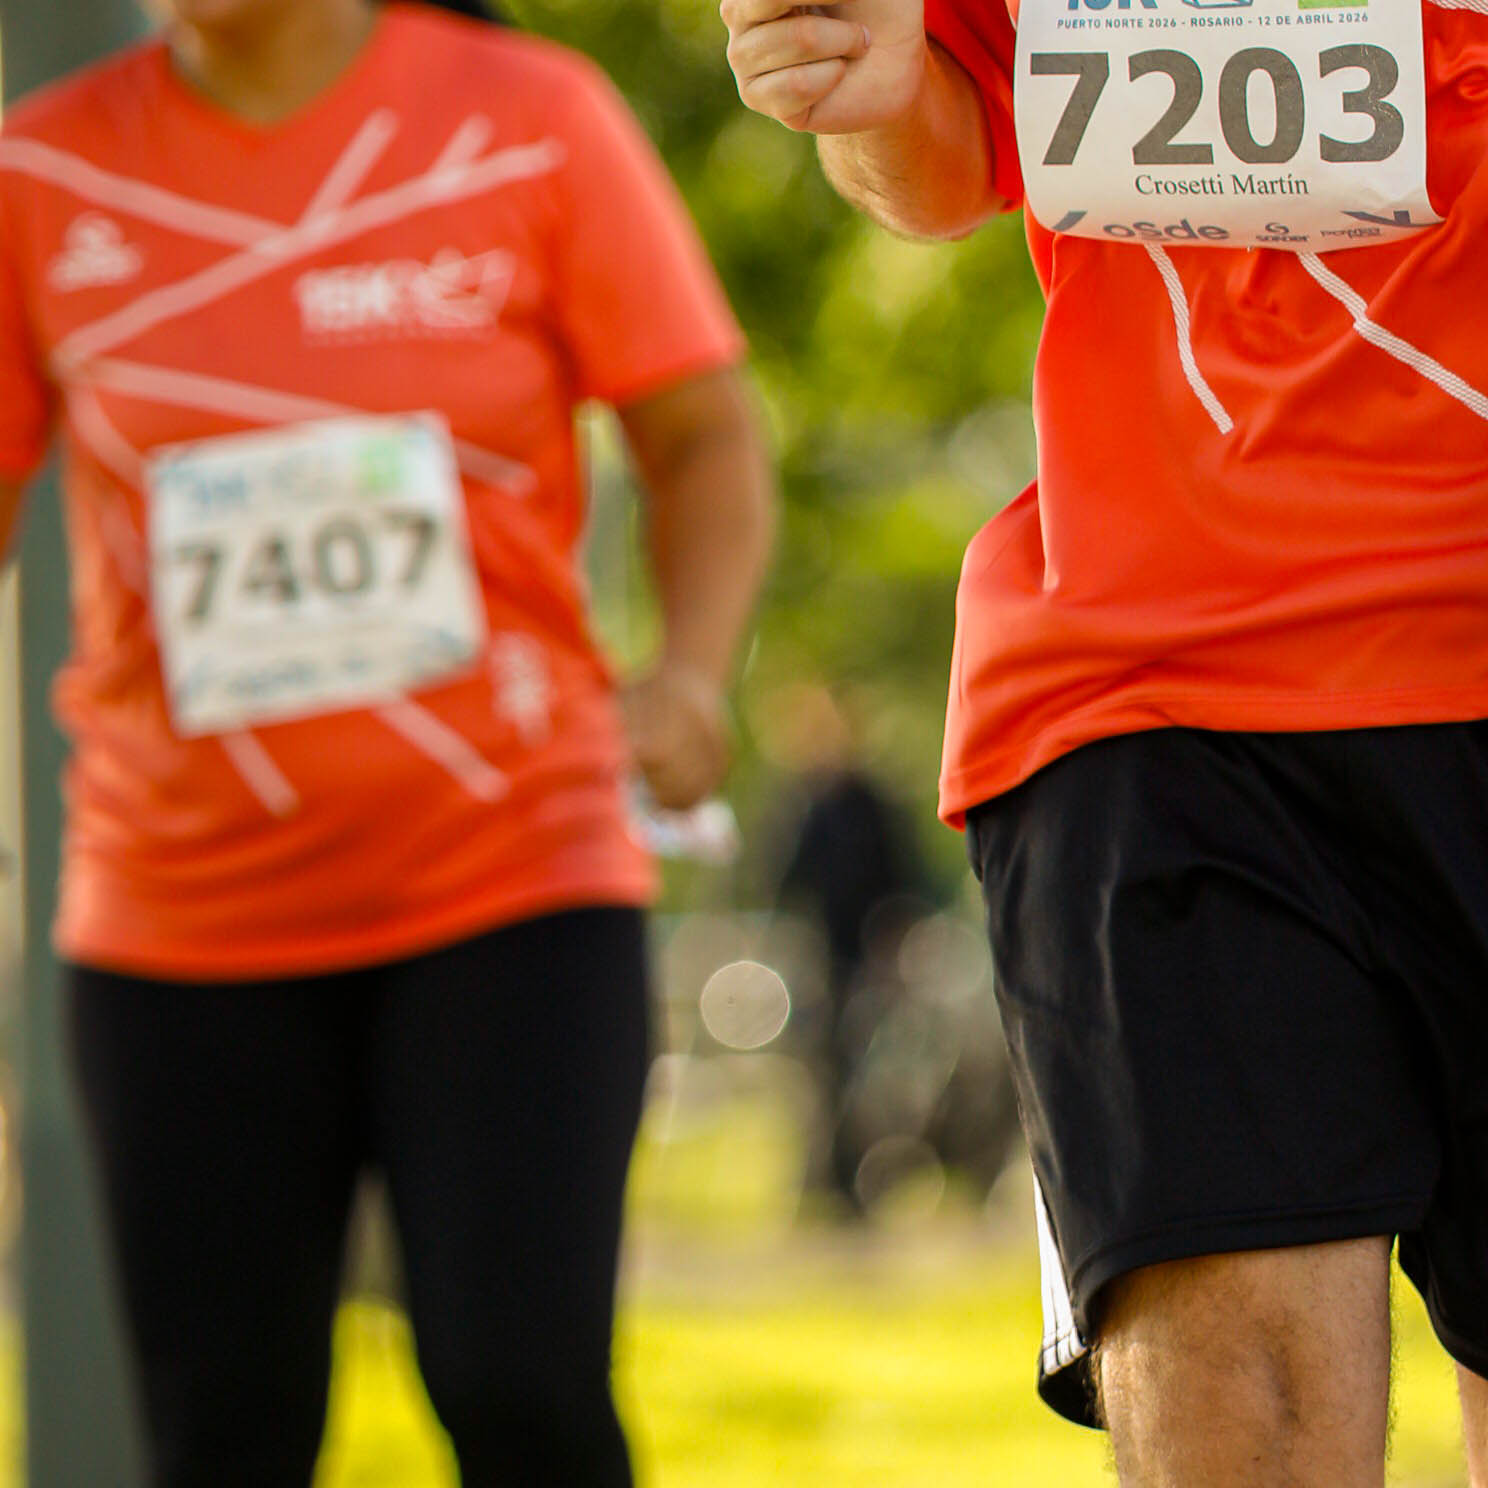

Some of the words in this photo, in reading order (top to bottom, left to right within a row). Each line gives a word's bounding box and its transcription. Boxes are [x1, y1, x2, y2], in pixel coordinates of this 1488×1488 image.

[1056, 17, 1102, 30] PUERTO
[1105, 17, 1144, 29] NORTE
[1149, 16, 1178, 29] 2026
[1190, 15, 1244, 28] ROSARIO
[1257, 15, 1272, 27] 12
[1275, 14, 1292, 26] DE
[1296, 14, 1334, 26] ABRIL
[1338, 12, 1369, 24] 2026
[1029, 43, 1405, 166] 7203
[1133, 173, 1225, 196] Crosetti
[1232, 172, 1310, 196] Martín
[1102, 218, 1231, 241] osde
[172, 506, 441, 628] 7407
